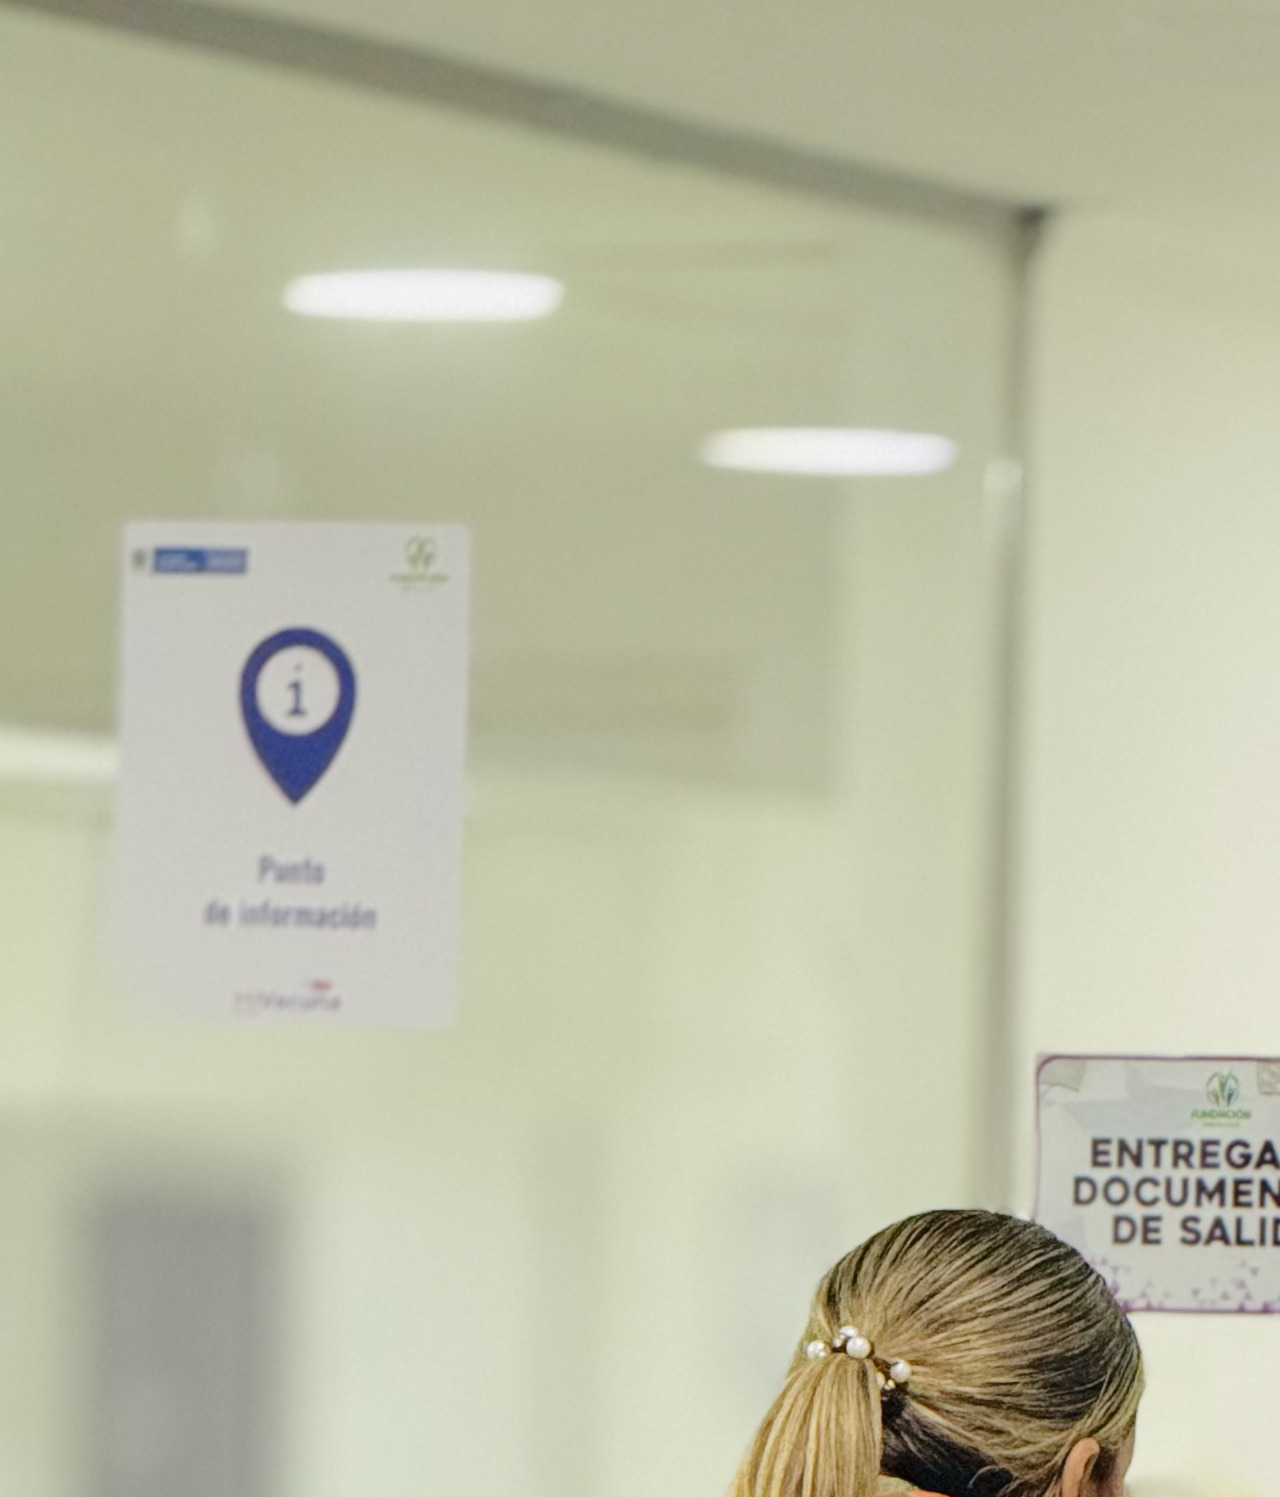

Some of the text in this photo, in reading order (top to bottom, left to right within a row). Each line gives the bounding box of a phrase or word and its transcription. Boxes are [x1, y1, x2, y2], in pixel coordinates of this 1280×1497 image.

[258, 854, 326, 884] Punto
[204, 899, 378, 930] de información
[1111, 1215, 1163, 1245] DE
